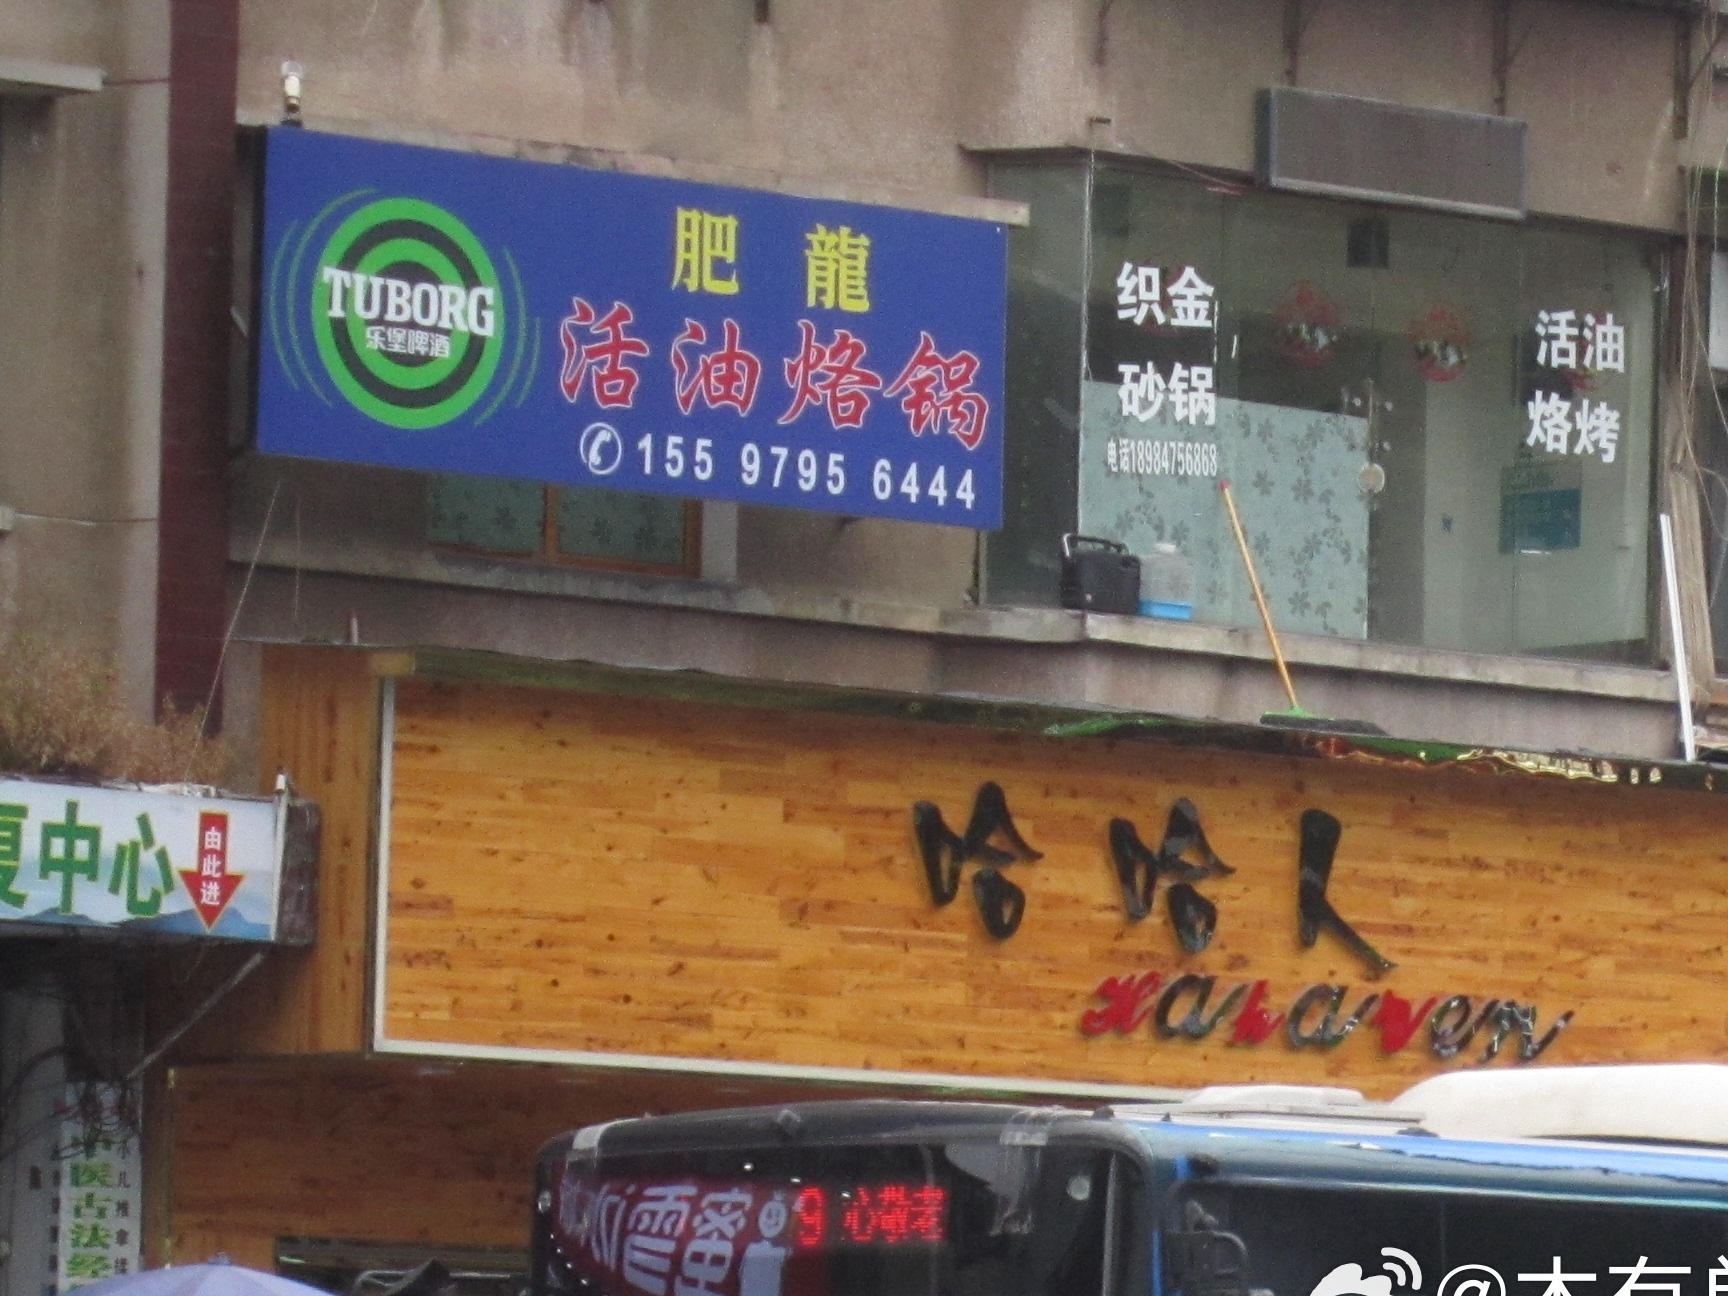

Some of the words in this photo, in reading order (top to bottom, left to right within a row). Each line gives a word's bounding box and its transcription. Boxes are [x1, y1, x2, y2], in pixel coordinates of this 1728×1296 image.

[671, 206, 872, 314] 肥龍
[1116, 261, 1216, 328] 织金
[323, 266, 494, 337] TUBORG
[366, 325, 450, 358] 乐堡啤酒
[559, 297, 991, 450] 活油烙锅
[1534, 309, 1626, 374] 活油
[1117, 361, 1217, 425] 砂锅
[1526, 390, 1622, 463] 烙烤
[638, 432, 713, 480] 155
[740, 442, 846, 495] 9795
[872, 458, 976, 510] 6444
[201, 825, 222, 906] 由此进
